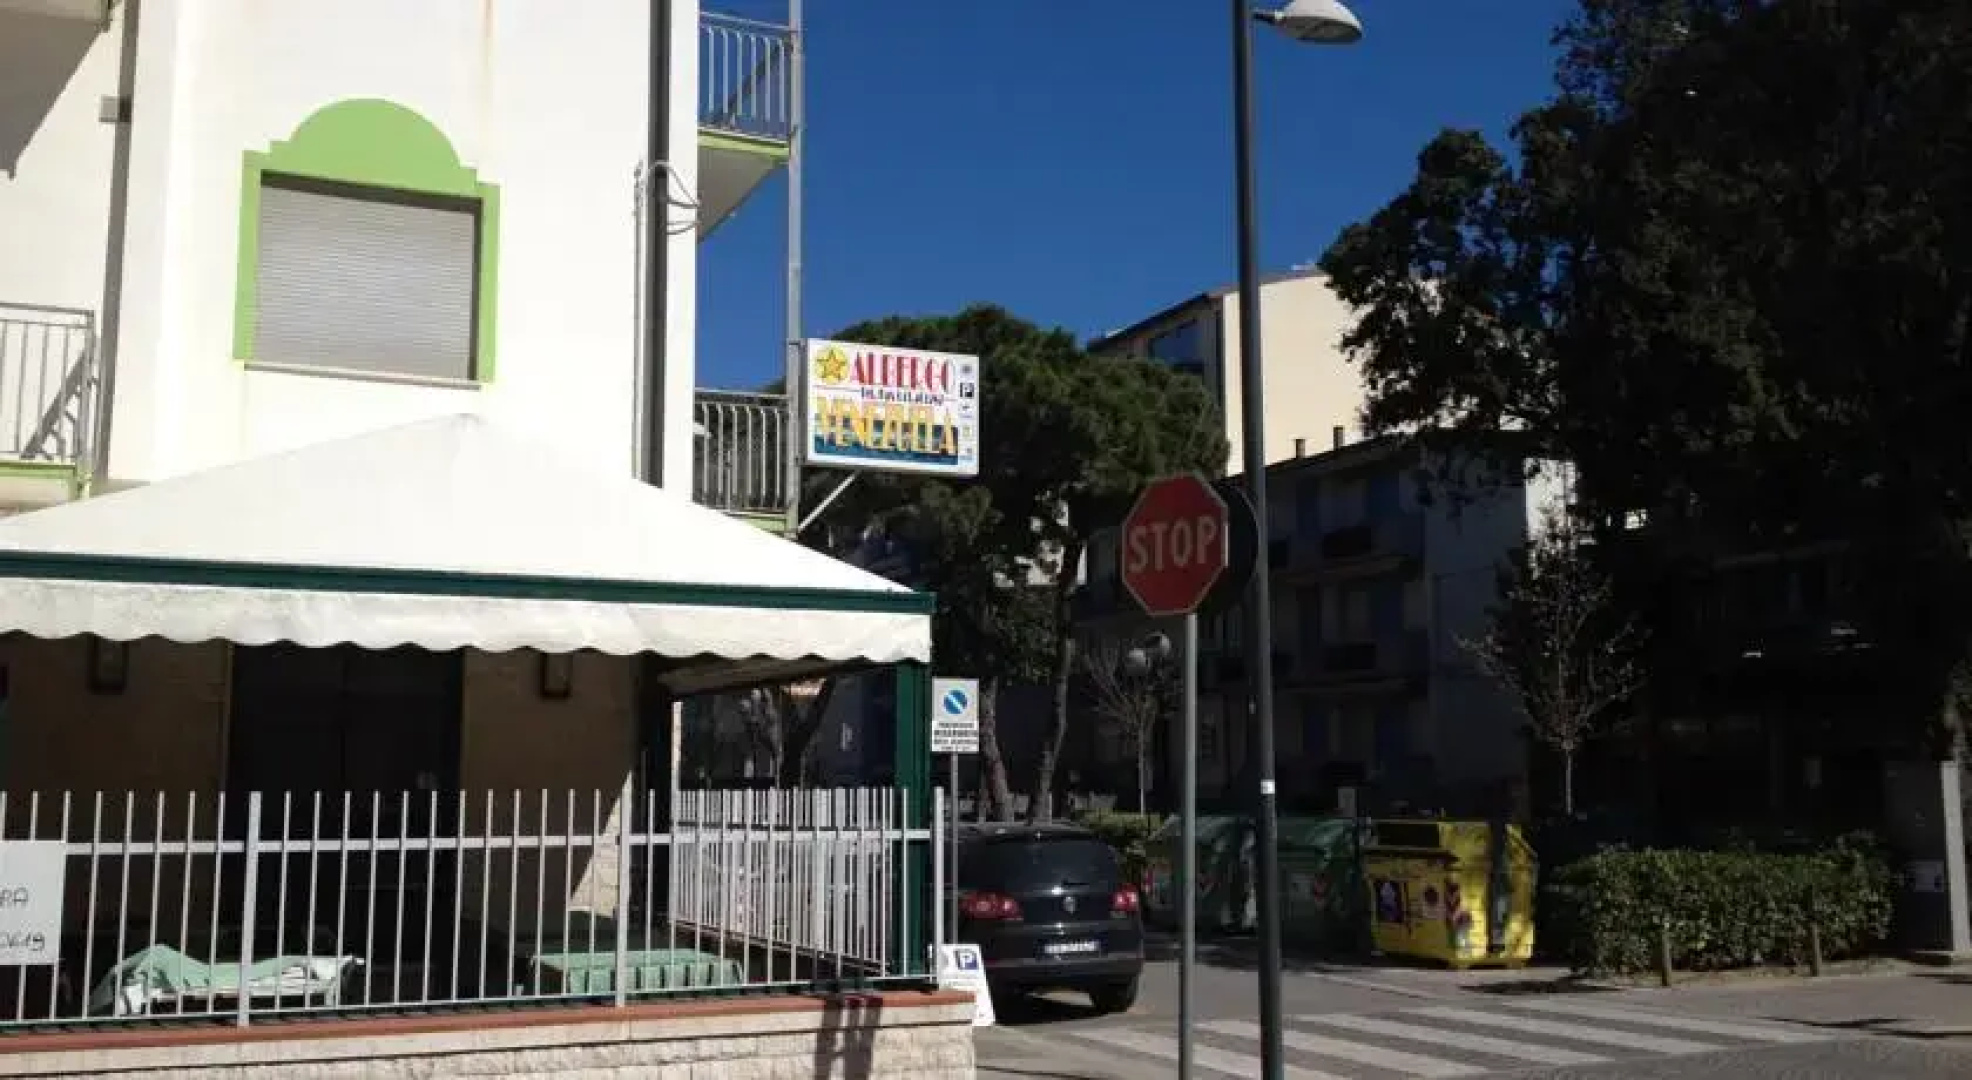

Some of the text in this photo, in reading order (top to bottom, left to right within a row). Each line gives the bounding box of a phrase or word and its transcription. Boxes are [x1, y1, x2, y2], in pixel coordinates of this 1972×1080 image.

[851, 351, 956, 395] ALBERGO
[816, 396, 958, 456] VENEZUELA
[1128, 515, 1218, 573] STOP
